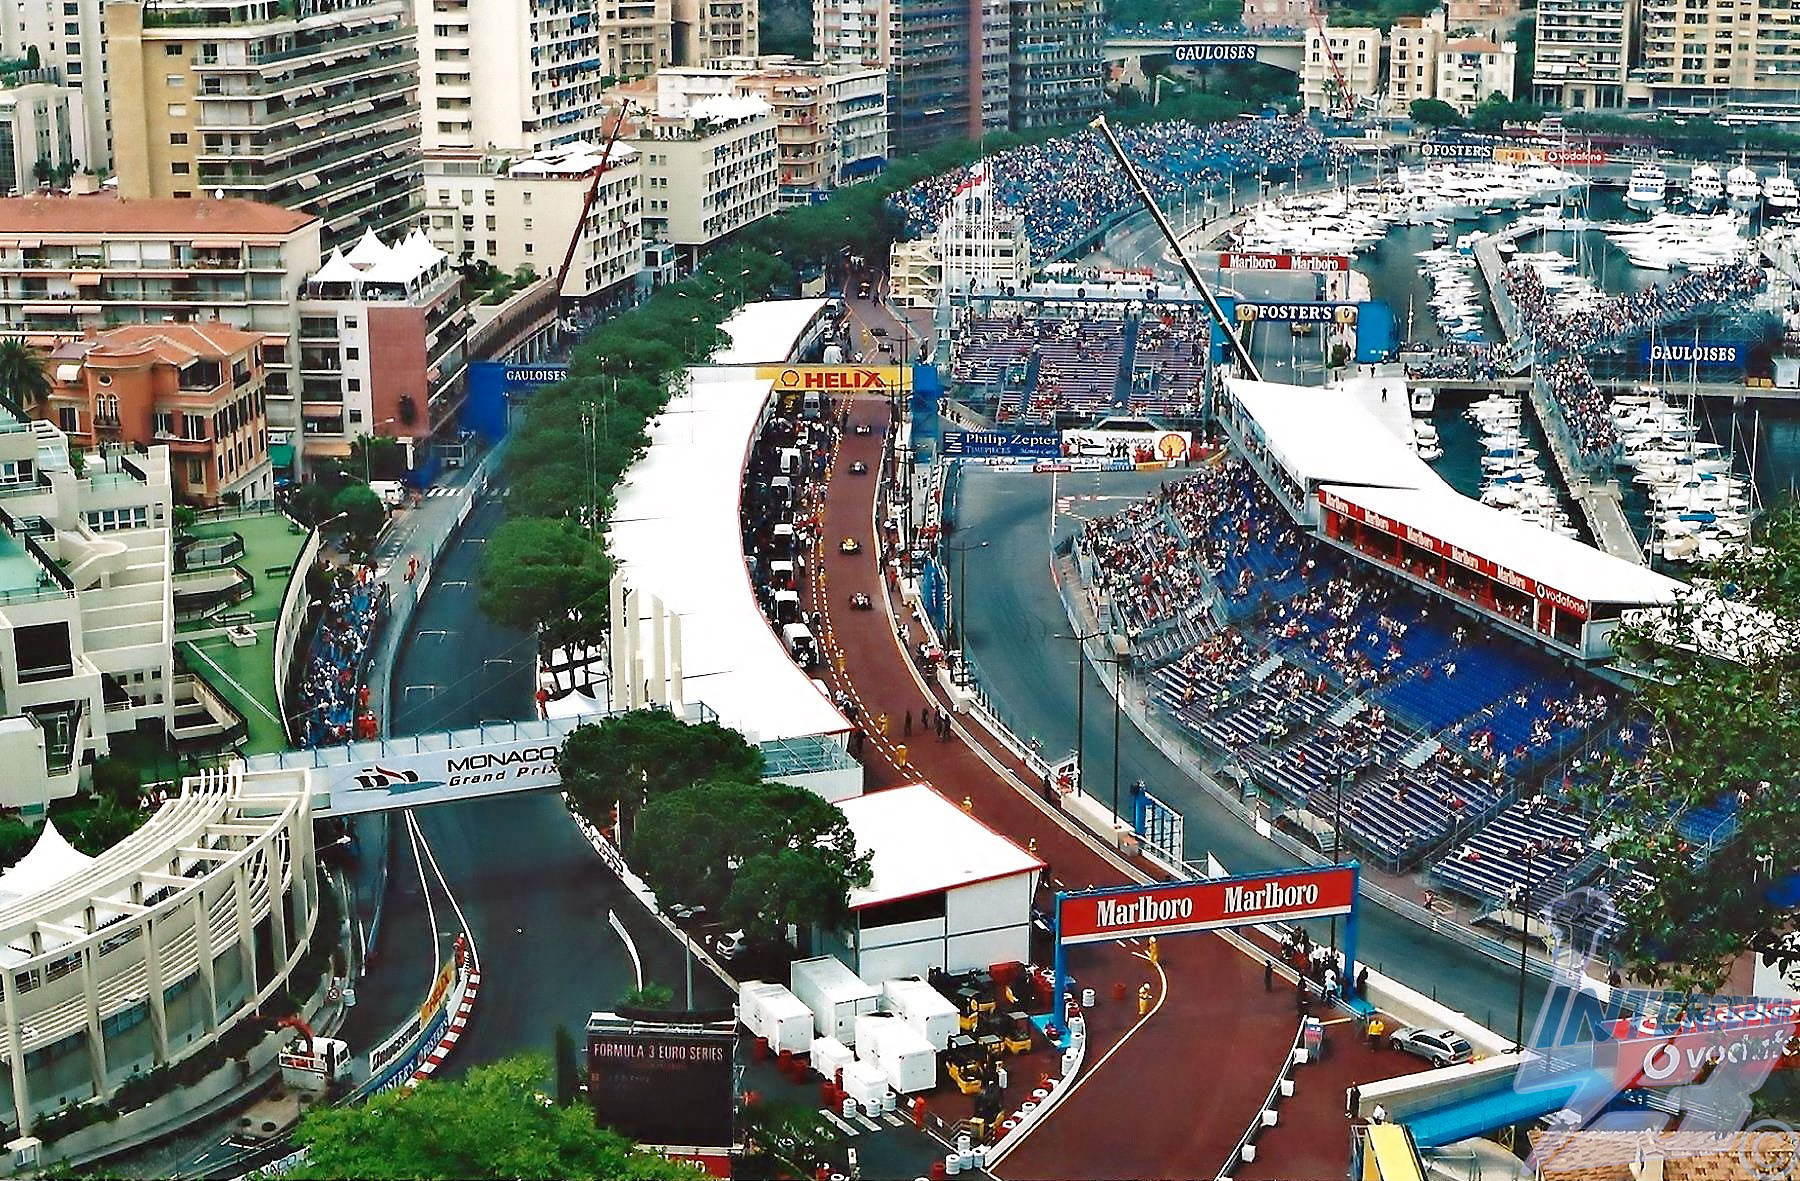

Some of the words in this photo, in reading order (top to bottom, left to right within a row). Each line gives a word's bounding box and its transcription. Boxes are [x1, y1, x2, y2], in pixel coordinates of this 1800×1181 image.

[1175, 46, 1256, 60] GAULOISES
[1434, 145, 1492, 157] FOSTER'S
[1230, 255, 1277, 269] Marlboro
[1291, 257, 1338, 270] Marlboro
[1259, 305, 1332, 319] FOSTER'S
[1652, 346, 1736, 361] GAULOISES
[506, 370, 567, 380] GAULOISES
[804, 369, 887, 388] HELIX
[966, 433, 1006, 446] Philip
[1011, 435, 1058, 446] Zepter
[1546, 588, 1586, 614] vodafone
[448, 746, 556, 772] MONACO
[449, 771, 505, 787] Grand
[516, 763, 560, 778] Prix
[1096, 895, 1193, 927] Marlboro
[1223, 882, 1319, 914] Marlboro
[594, 1043, 644, 1057] FORMULA
[649, 1045, 655, 1058] 3
[659, 1046, 686, 1059] EURO
[689, 1047, 723, 1060] SERIES
